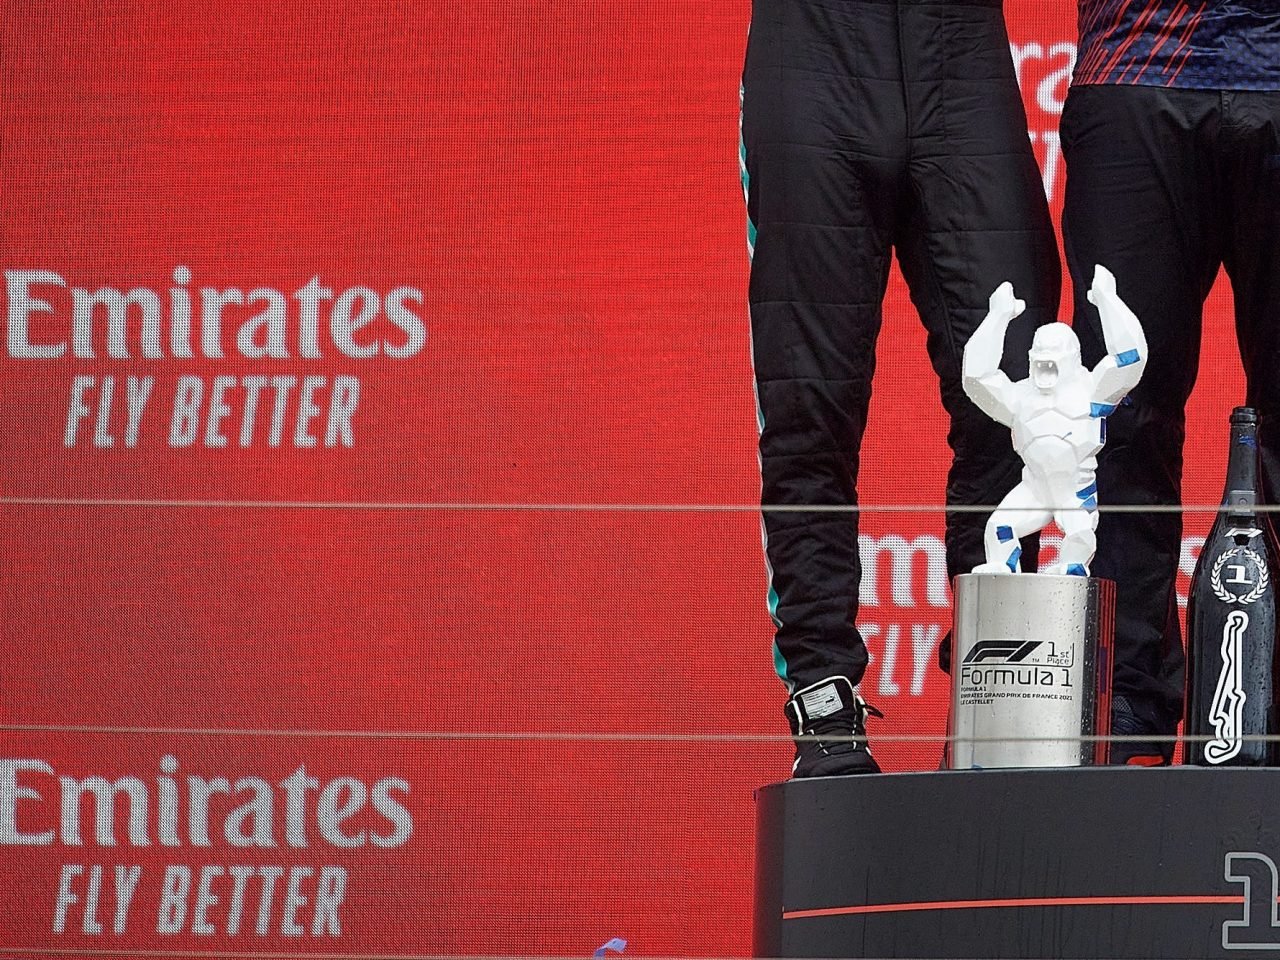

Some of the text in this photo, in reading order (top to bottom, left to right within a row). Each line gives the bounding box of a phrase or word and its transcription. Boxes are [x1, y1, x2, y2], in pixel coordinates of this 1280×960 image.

[4, 265, 427, 360] Emirates
[63, 373, 360, 449] FLY BETTER
[1226, 564, 1253, 585] 1
[961, 667, 1073, 687] Formula 1
[0, 754, 413, 848] Emirates
[52, 863, 349, 937] FLY BETTER
